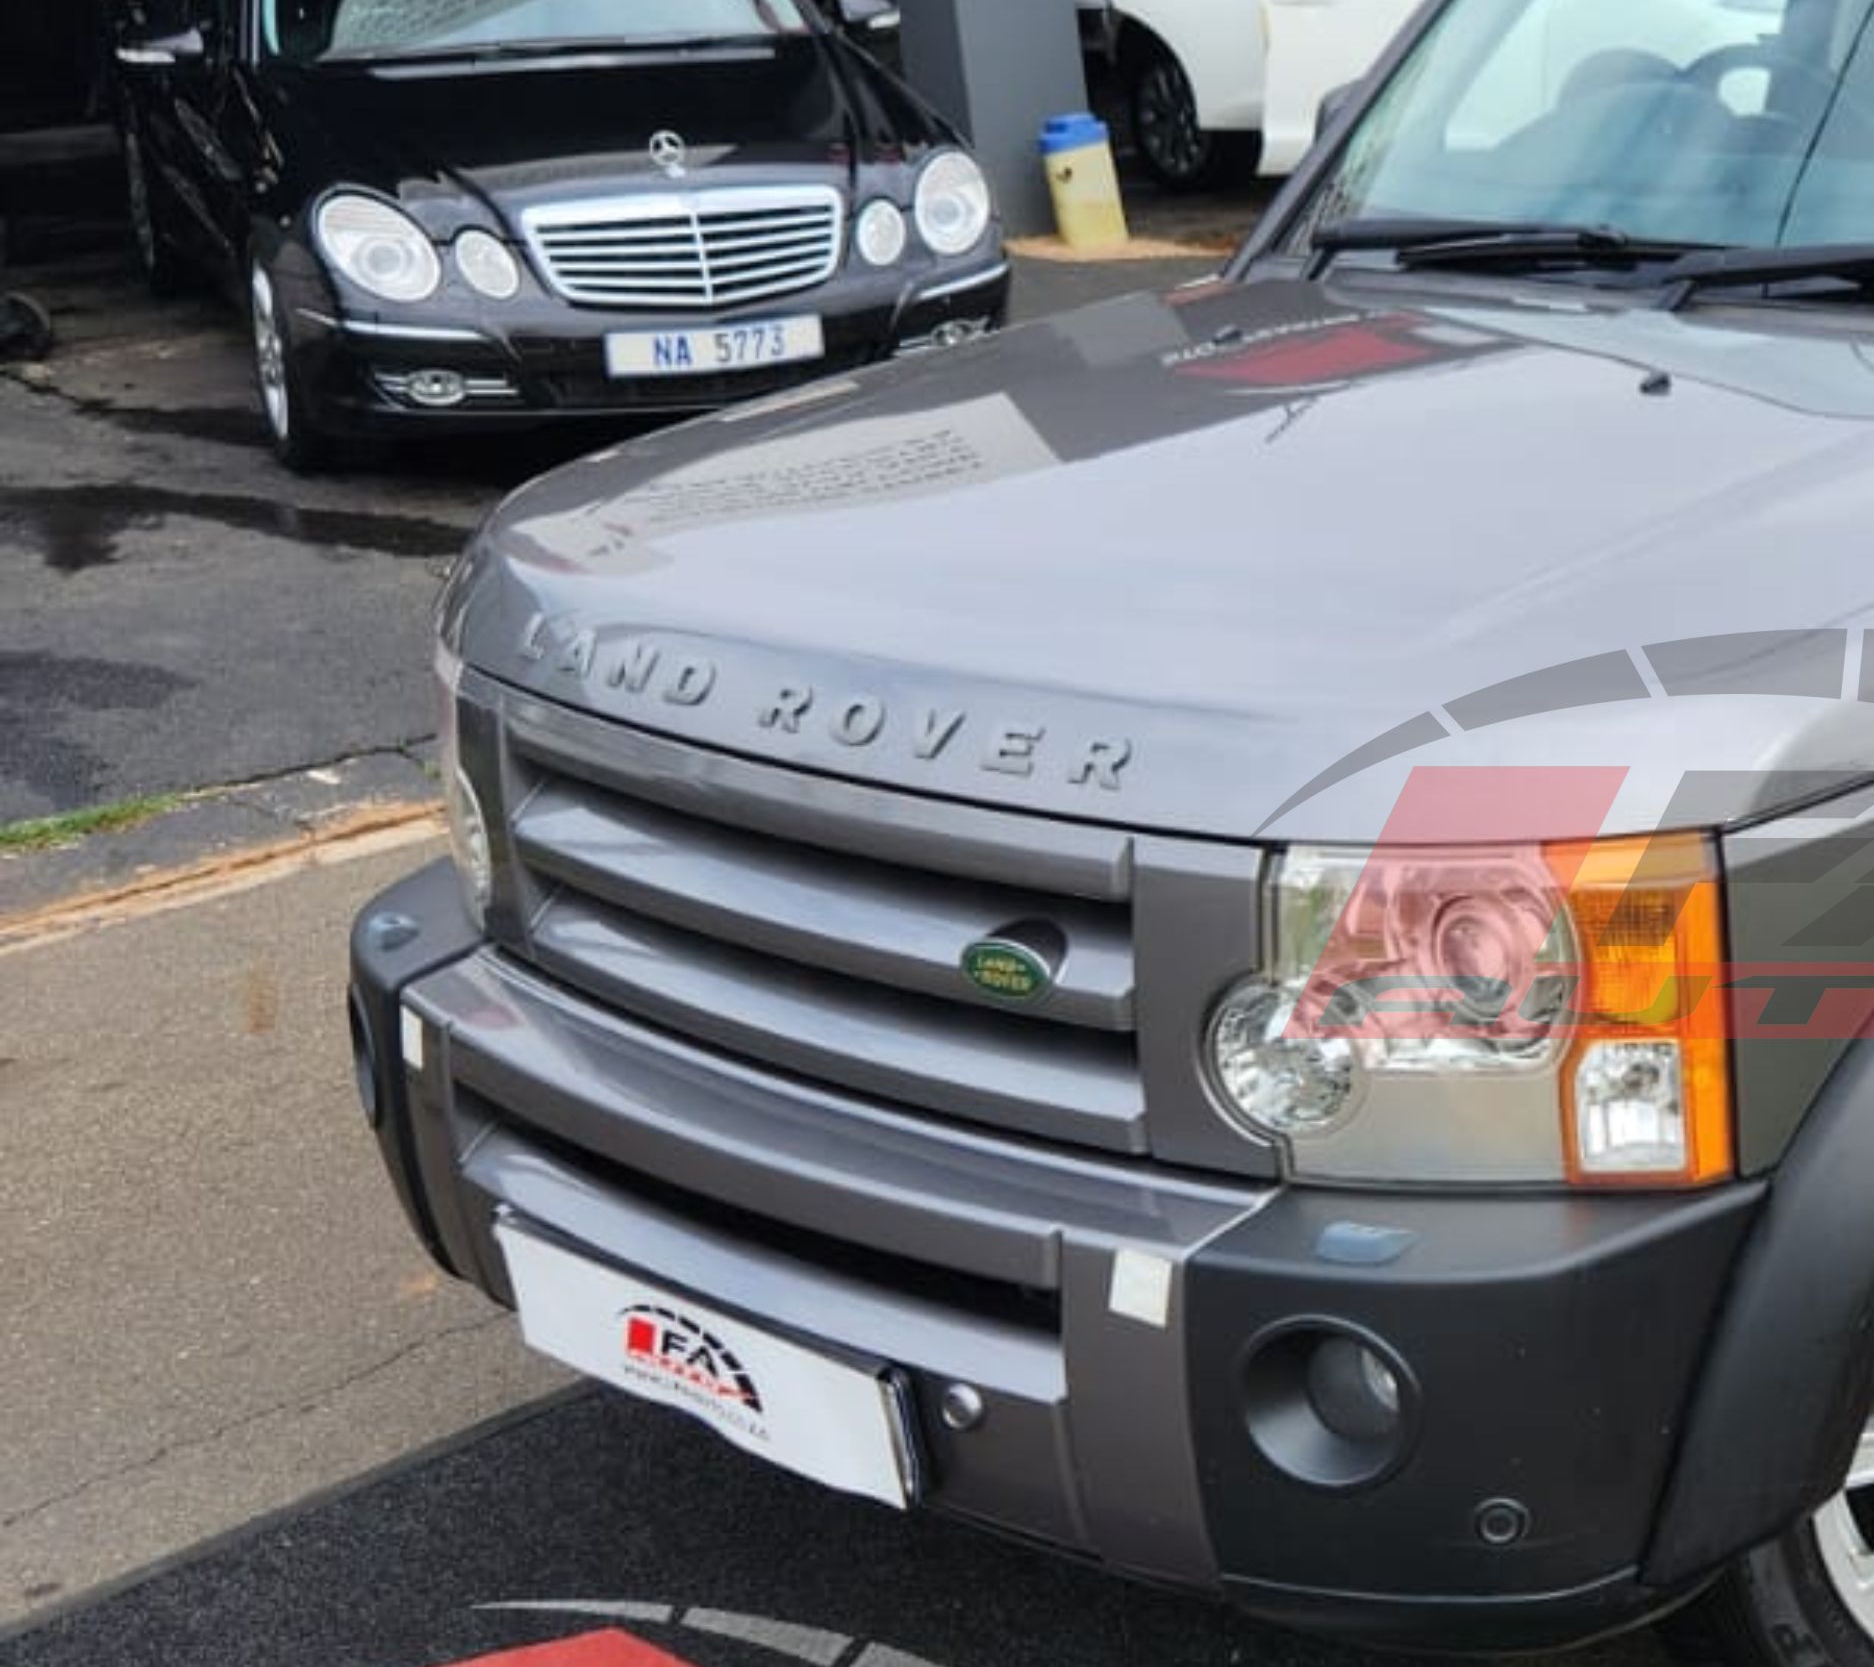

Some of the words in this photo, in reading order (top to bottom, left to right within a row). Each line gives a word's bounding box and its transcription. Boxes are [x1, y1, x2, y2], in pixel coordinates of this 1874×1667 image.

[653, 335, 692, 366] NA
[714, 325, 785, 364] 5773
[520, 612, 718, 707] LAND
[758, 683, 1134, 791] ROVER
[975, 953, 1027, 974] LAND
